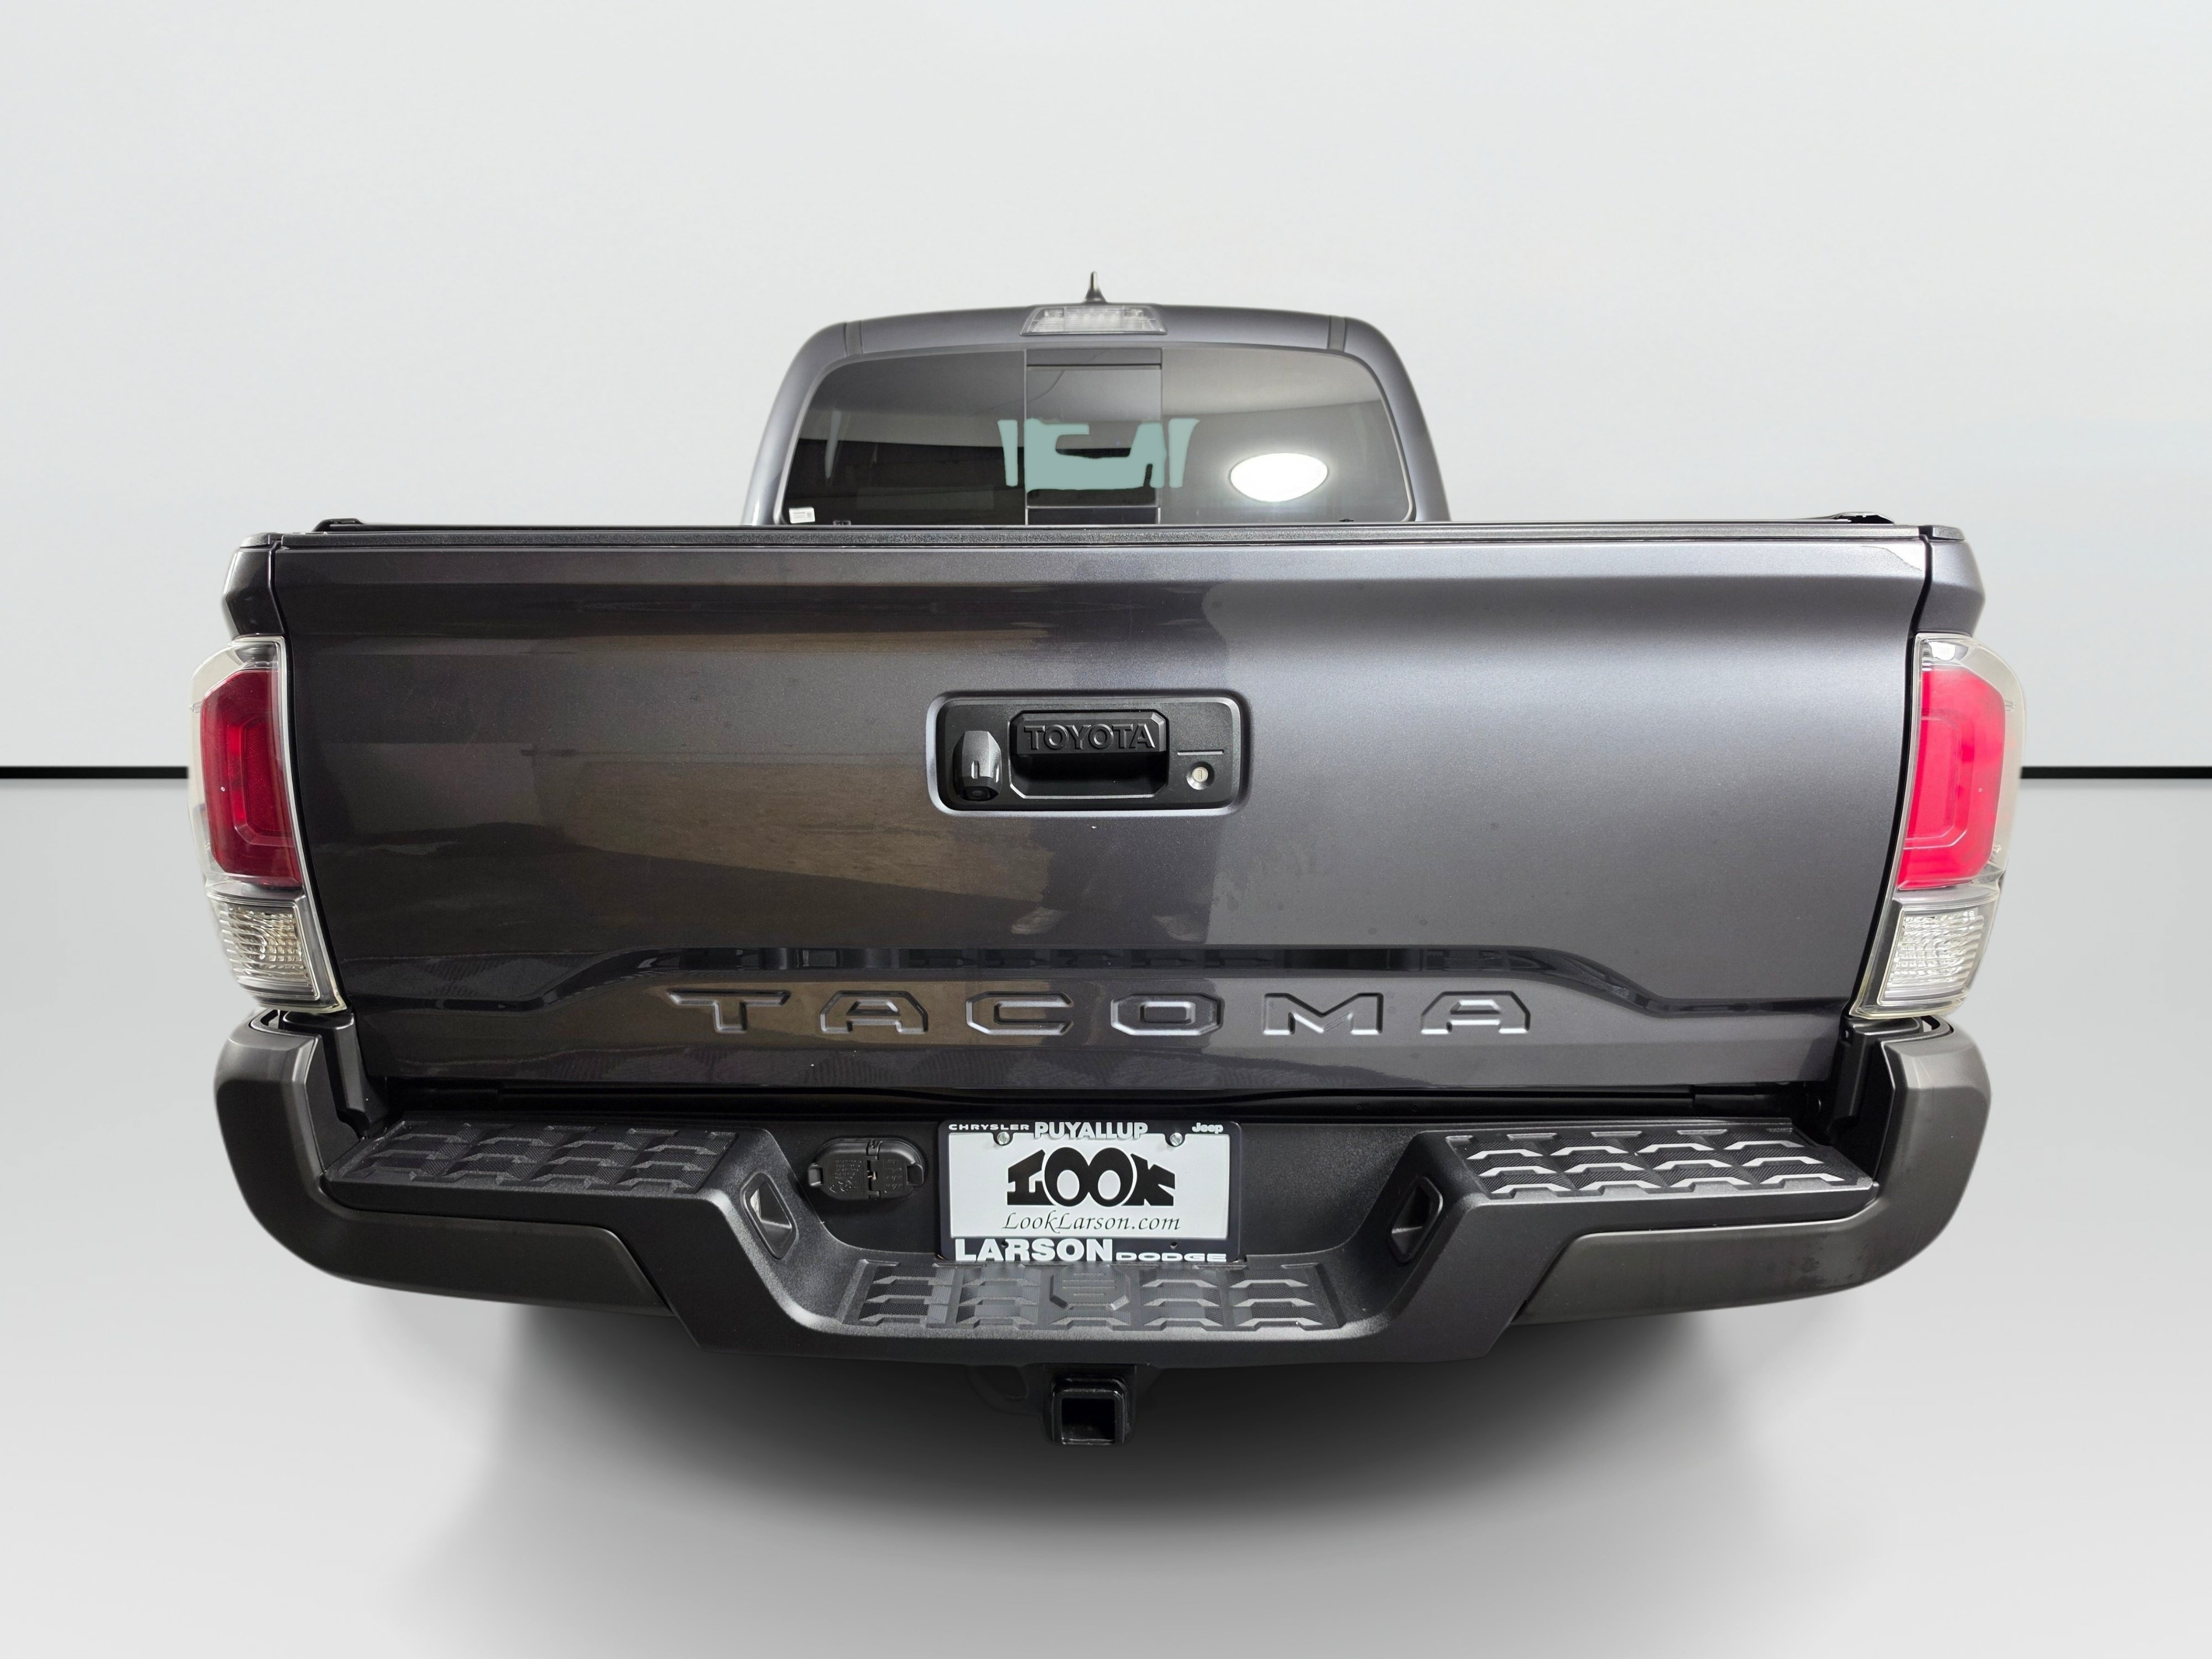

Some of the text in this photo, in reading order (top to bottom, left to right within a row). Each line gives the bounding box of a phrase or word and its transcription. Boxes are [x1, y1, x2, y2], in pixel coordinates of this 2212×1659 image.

[1024, 723, 1156, 750] TOYOTA
[668, 990, 1531, 1035] TACOMA
[1034, 1121, 1148, 1139] PUYALLUP
[1192, 1123, 1223, 1134] Jeep
[1007, 1147, 1175, 1207] LOOK
[1001, 1210, 1181, 1234] LookLarson.com
[955, 1239, 1227, 1262] LARSON DODGE
